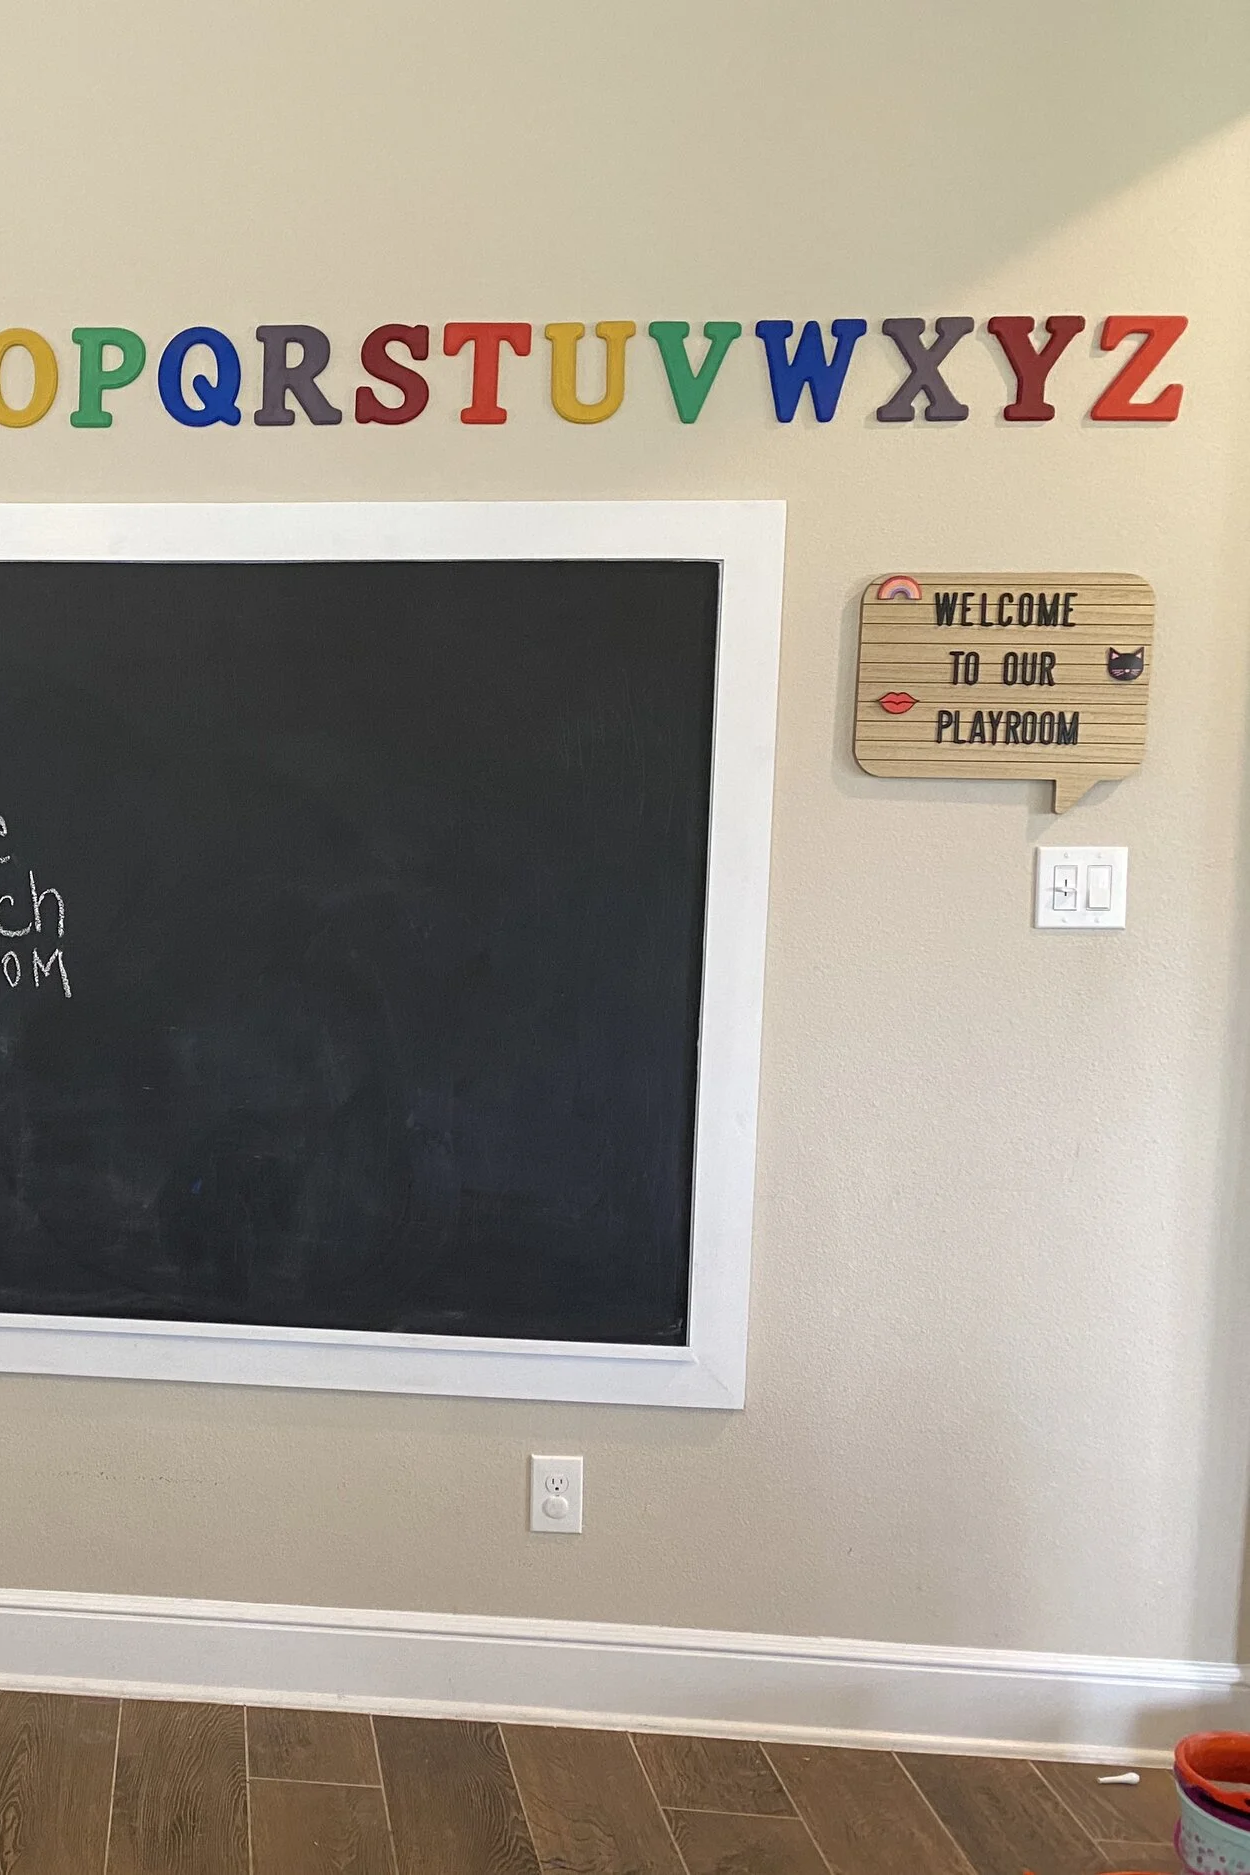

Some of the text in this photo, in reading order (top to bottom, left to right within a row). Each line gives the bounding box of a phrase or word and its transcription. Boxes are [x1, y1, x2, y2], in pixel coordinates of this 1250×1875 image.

[934, 592, 1079, 627] WELCOME
[949, 651, 1056, 686] TO OUR
[935, 710, 1080, 746] PLAYROOM
